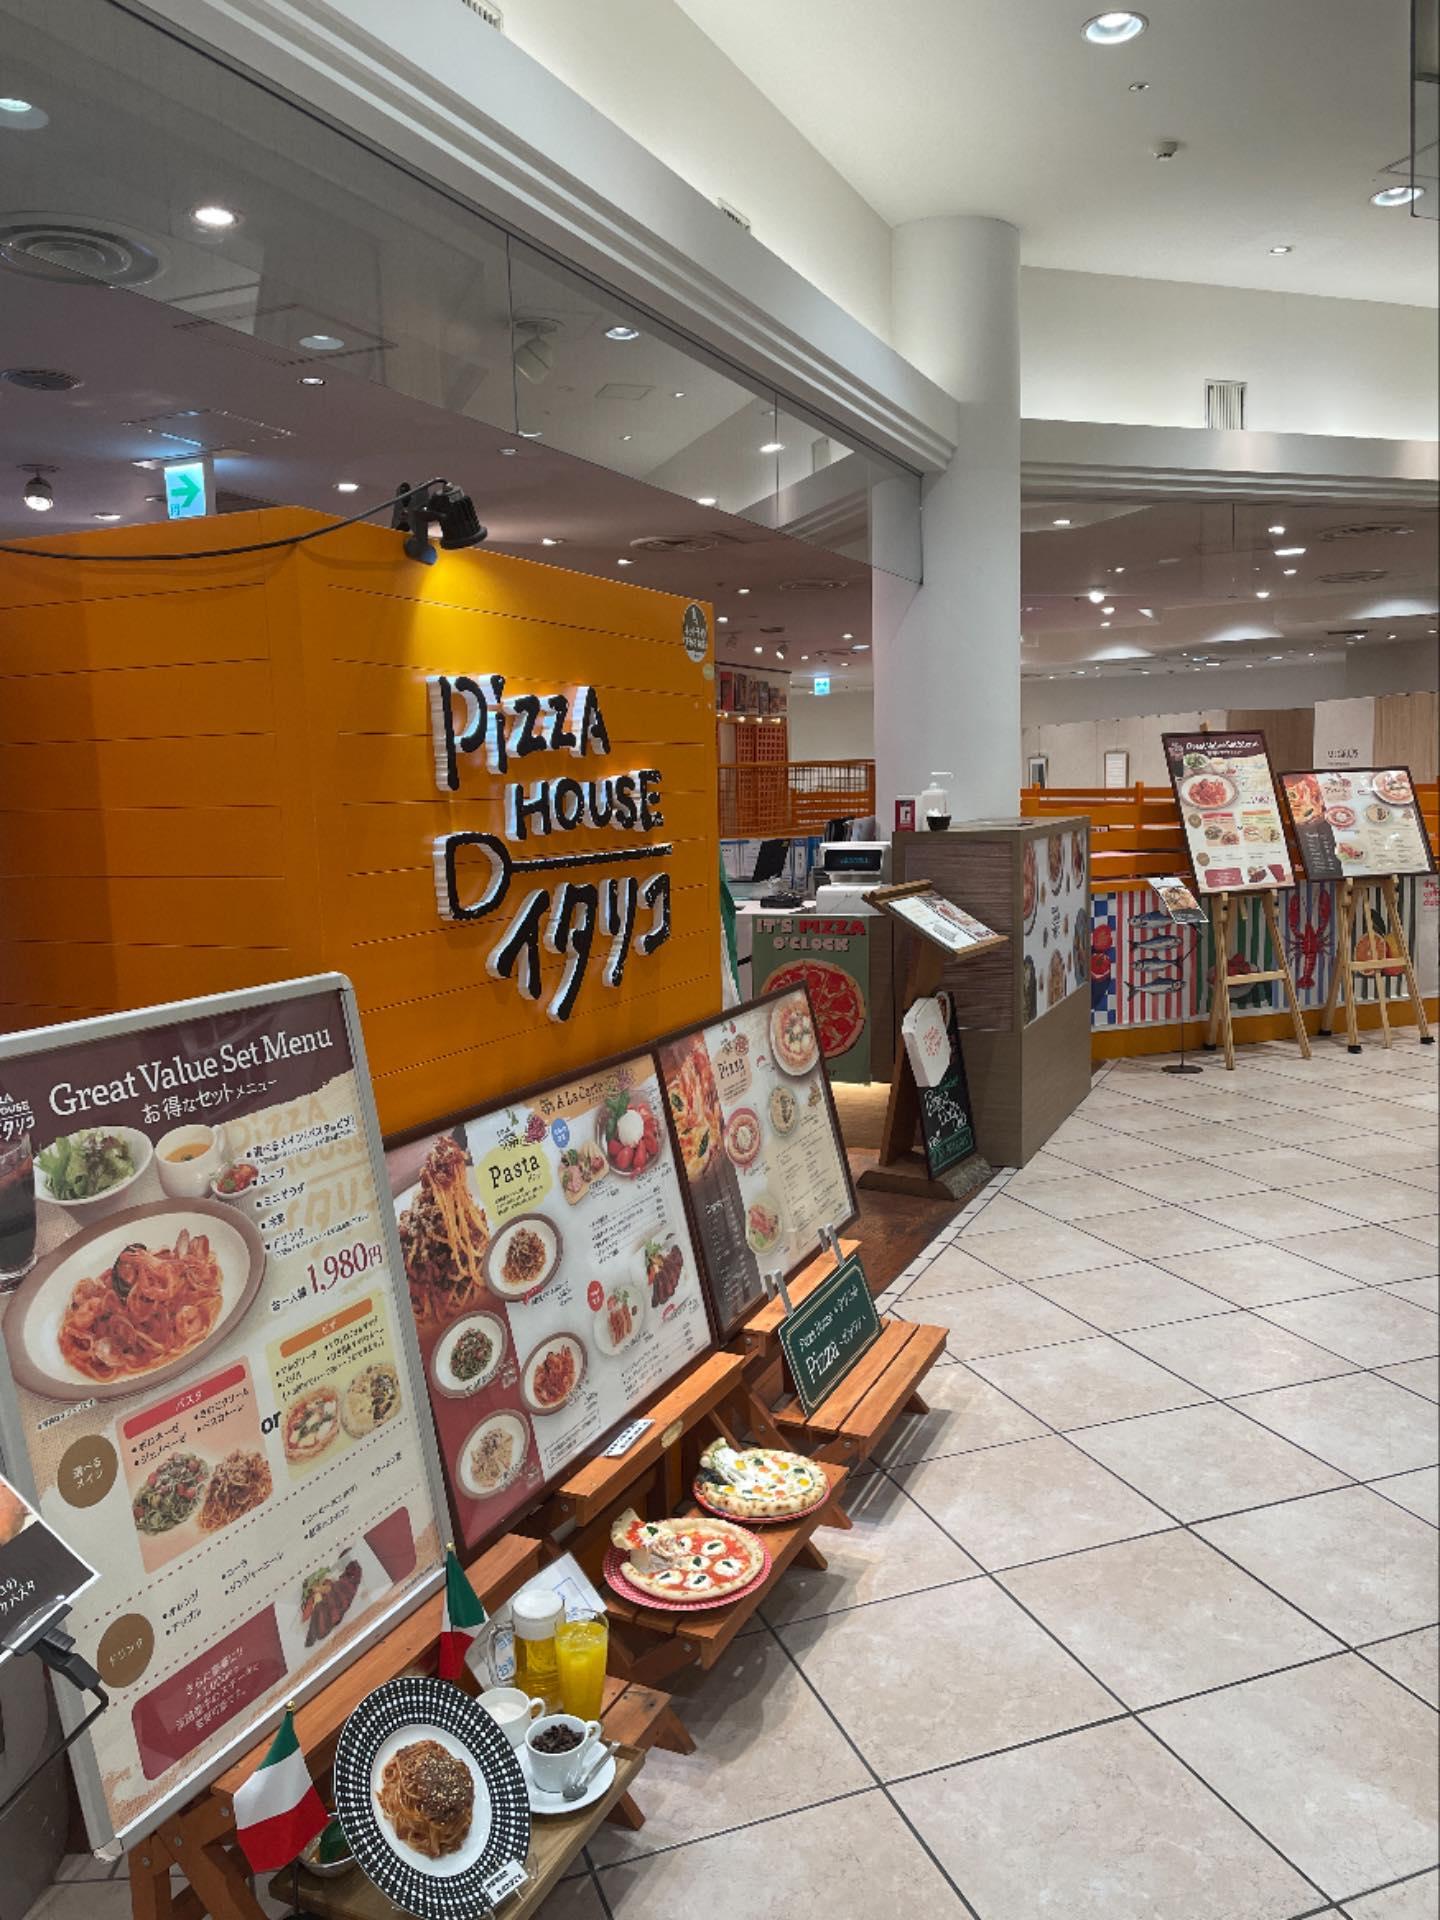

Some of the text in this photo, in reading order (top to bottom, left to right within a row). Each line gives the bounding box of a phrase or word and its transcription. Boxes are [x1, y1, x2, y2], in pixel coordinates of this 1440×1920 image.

[505, 769, 664, 841] HOUSE
[756, 918, 866, 935] IT'S PIZZA
[773, 937, 849, 951] O'CLOCK
[49, 1029, 334, 1116] Great Value Set Menu
[0, 1099, 30, 1115] OUSE
[141, 1079, 278, 1124] お得なセットメニュー
[488, 1155, 540, 1189] Pasta
[307, 1242, 382, 1295] 1,980円
[175, 1391, 203, 1411] パスタ
[261, 1410, 282, 1434] or
[76, 1470, 103, 1489] メイン
